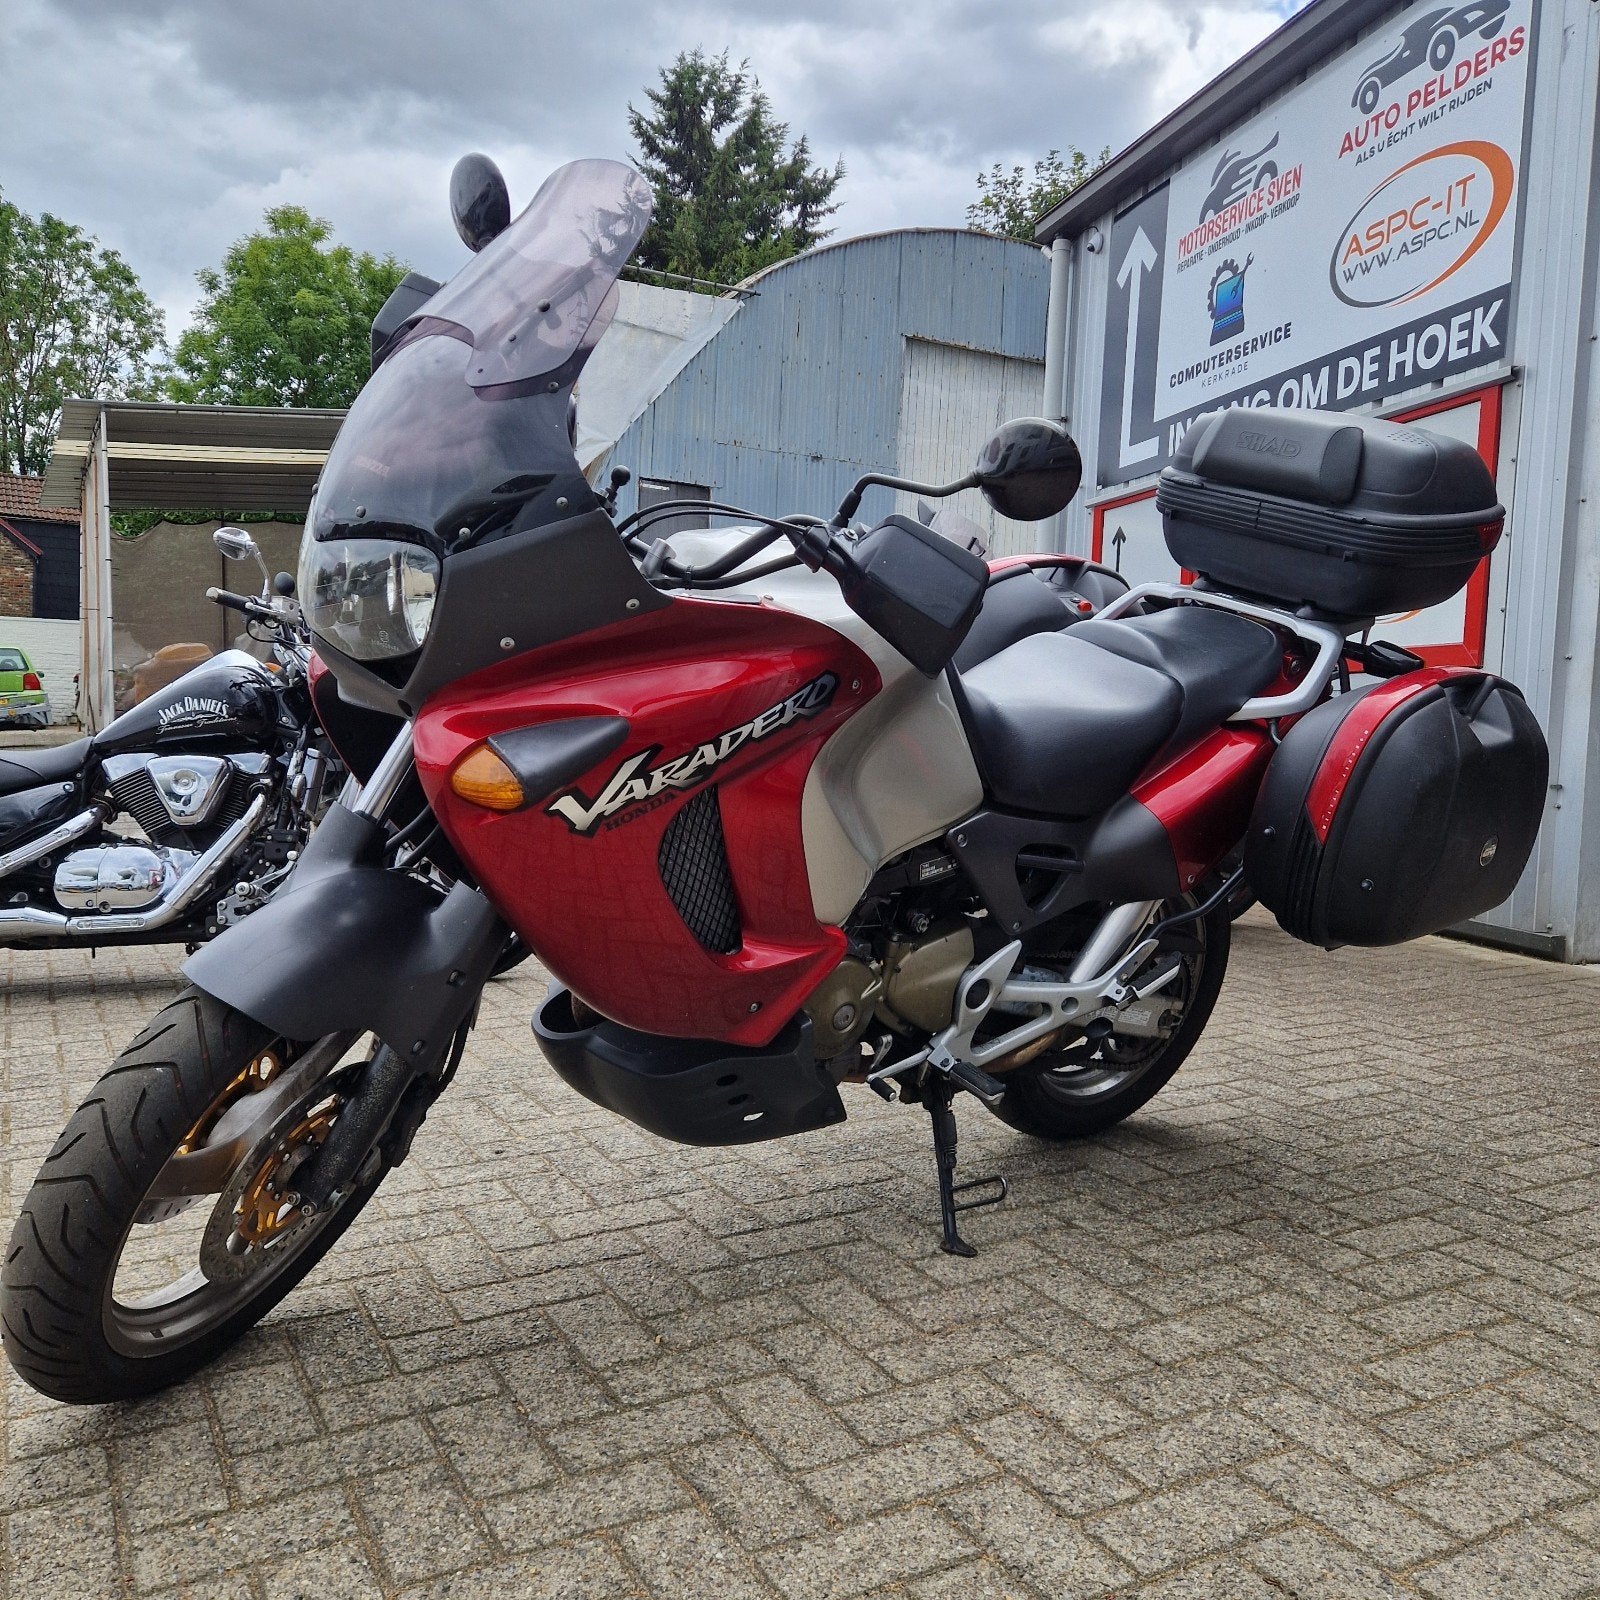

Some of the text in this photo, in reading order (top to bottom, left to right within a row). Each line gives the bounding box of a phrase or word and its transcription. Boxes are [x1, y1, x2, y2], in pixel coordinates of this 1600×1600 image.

[1338, 25, 1525, 159] AUTO PELDERS
[1355, 77, 1493, 166] ALS U ÉCHT WILT RIJDEN
[1177, 163, 1303, 260] MOTORSERVICE SVEN
[1207, 228, 1241, 256] ONDERHOUD
[1270, 193, 1300, 219] VERKOOP
[1342, 173, 1476, 266] ASPC-IT
[1342, 209, 1480, 284] WWW.ASPC.NL
[1169, 321, 1292, 389] COMPUTERSERVICE KERKRADE
[1277, 365, 1330, 409] OM
[1336, 346, 1381, 400] DE
[1387, 299, 1504, 383] HOEK
[158, 702, 185, 725] JACK
[605, 792, 678, 832] HONDA
